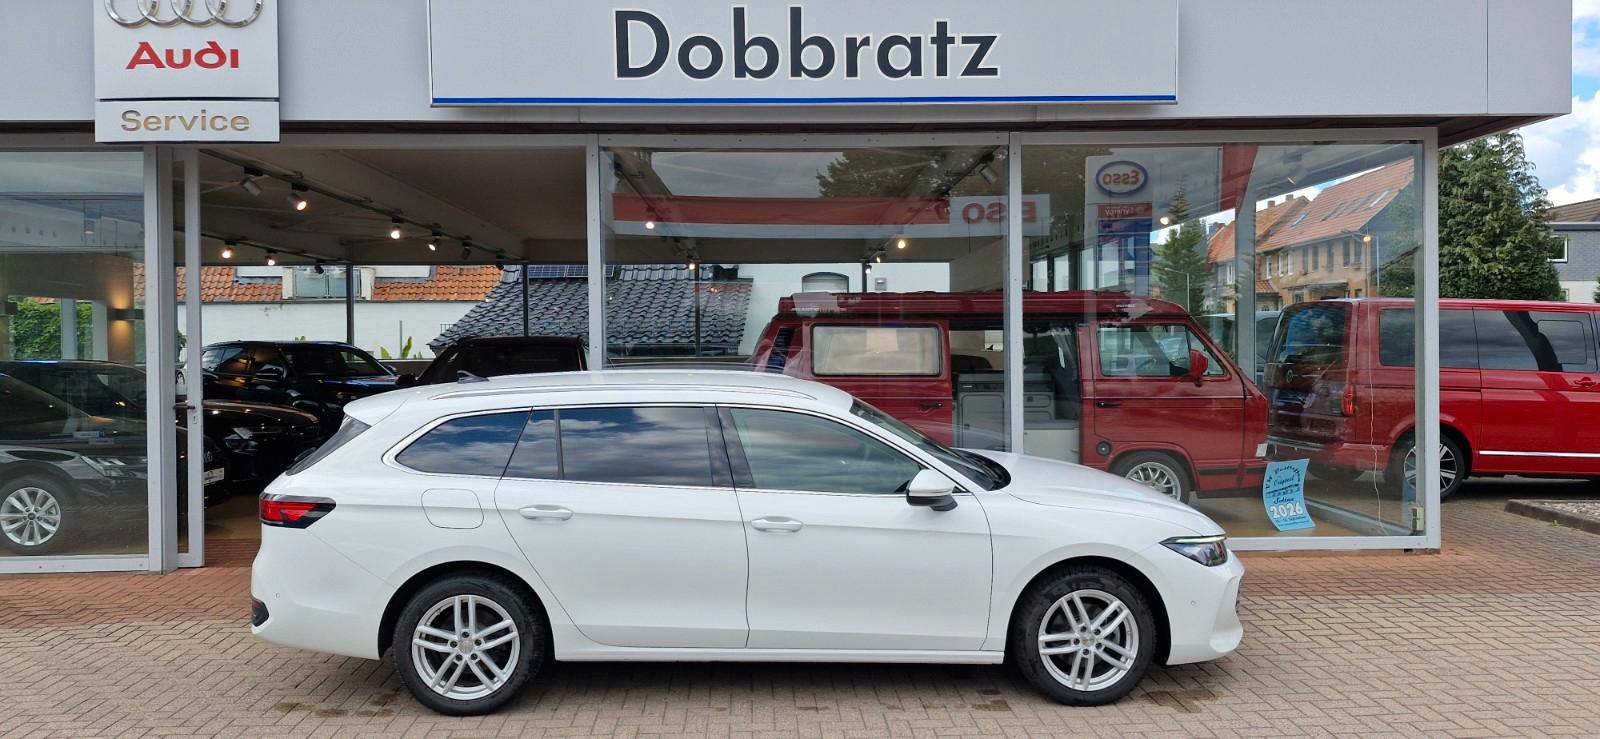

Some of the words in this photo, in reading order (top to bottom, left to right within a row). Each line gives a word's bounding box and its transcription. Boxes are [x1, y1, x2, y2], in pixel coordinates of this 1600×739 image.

[126, 41, 240, 69] Audi
[614, 6, 999, 79] Dobbratz
[121, 109, 250, 132] Service
[1270, 502, 1303, 518] 2026
